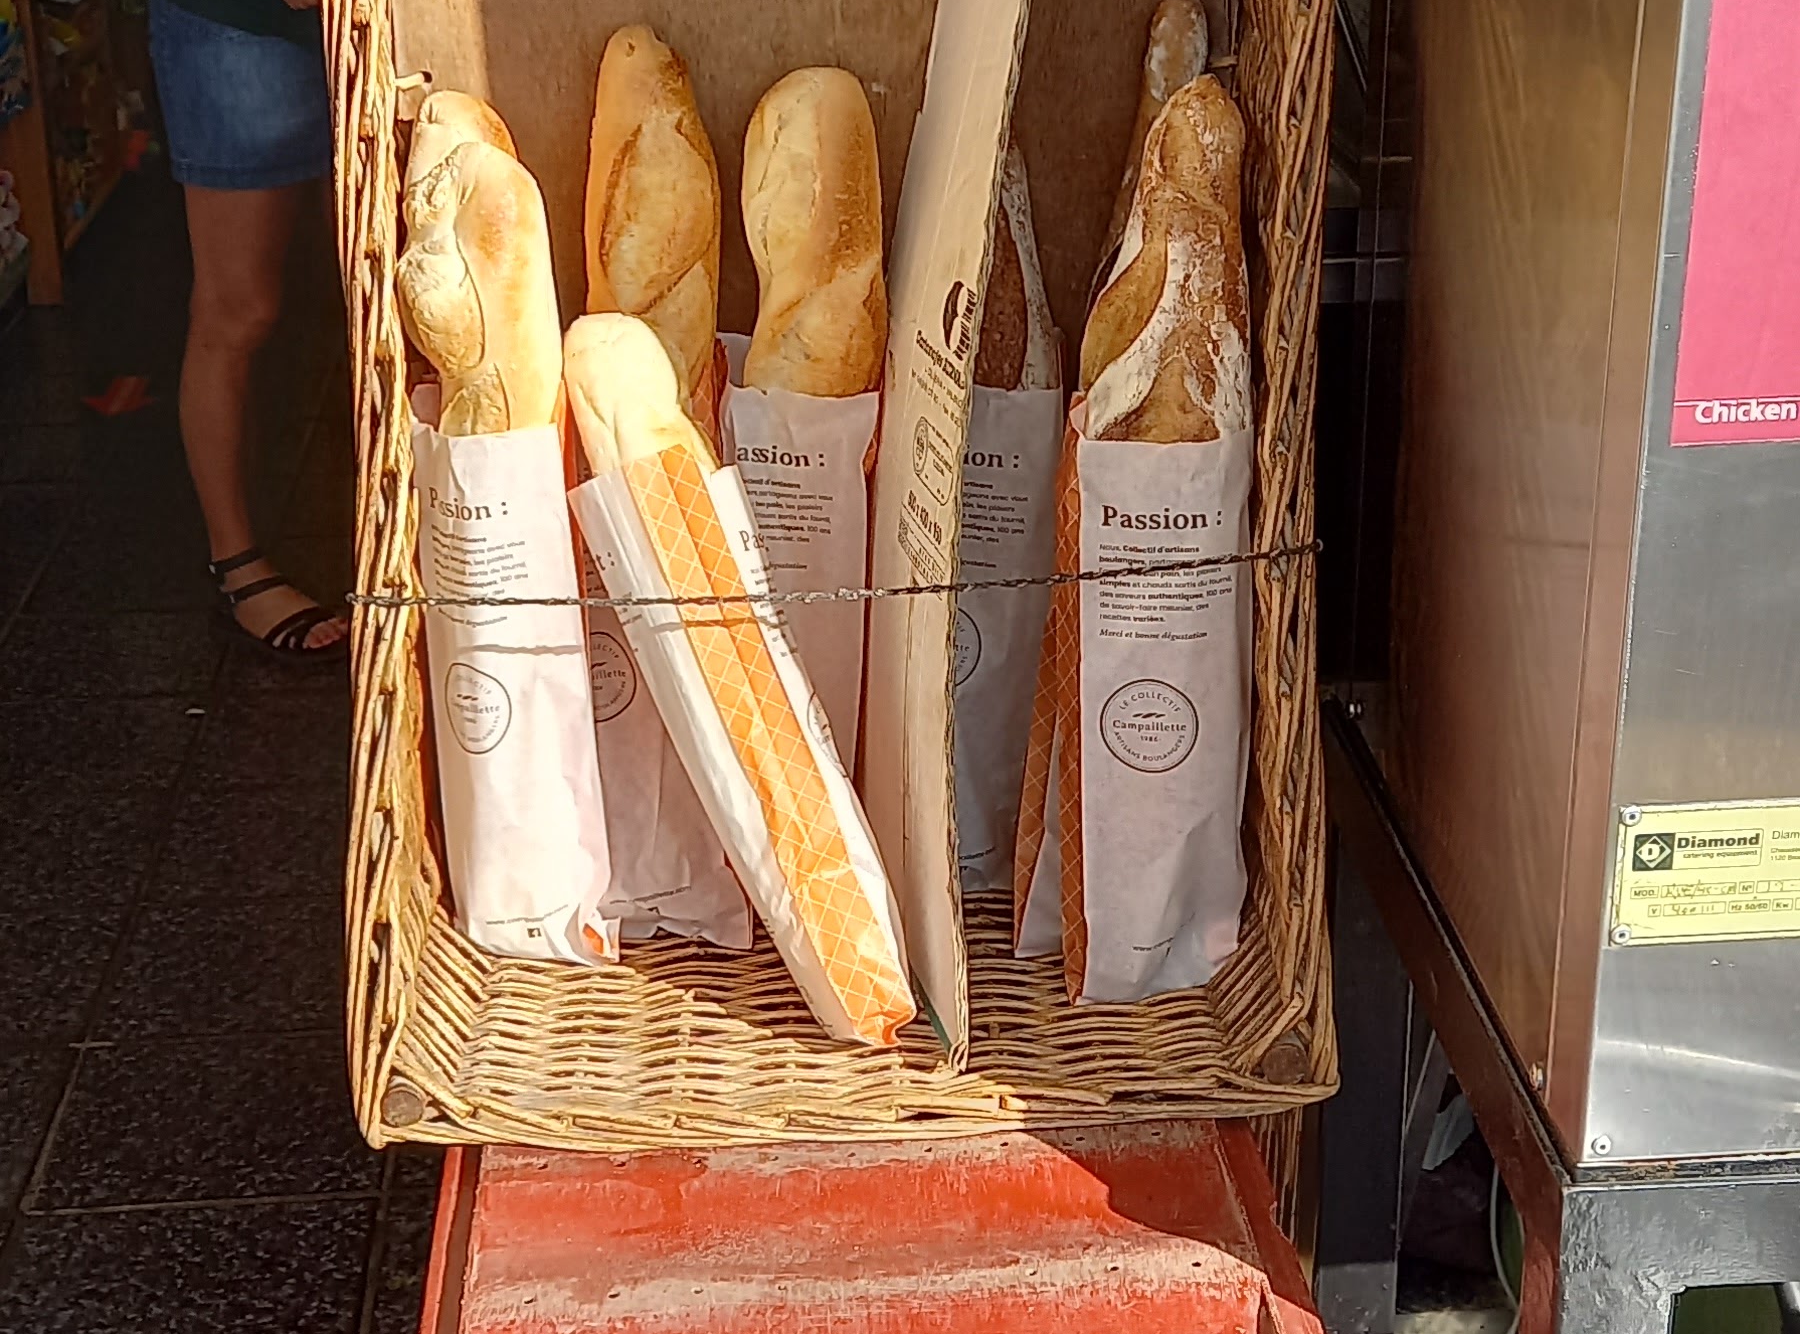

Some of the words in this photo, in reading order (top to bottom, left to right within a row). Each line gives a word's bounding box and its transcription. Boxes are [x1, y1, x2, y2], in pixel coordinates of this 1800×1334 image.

[1694, 398, 1797, 424] Chicken
[737, 445, 811, 467] assion
[1101, 505, 1208, 530] Passion
[1216, 510, 1222, 526] :
[1131, 691, 1182, 712] COLLECTIF
[1112, 719, 1187, 733] Campaillette
[1677, 833, 1760, 849] Diamond
